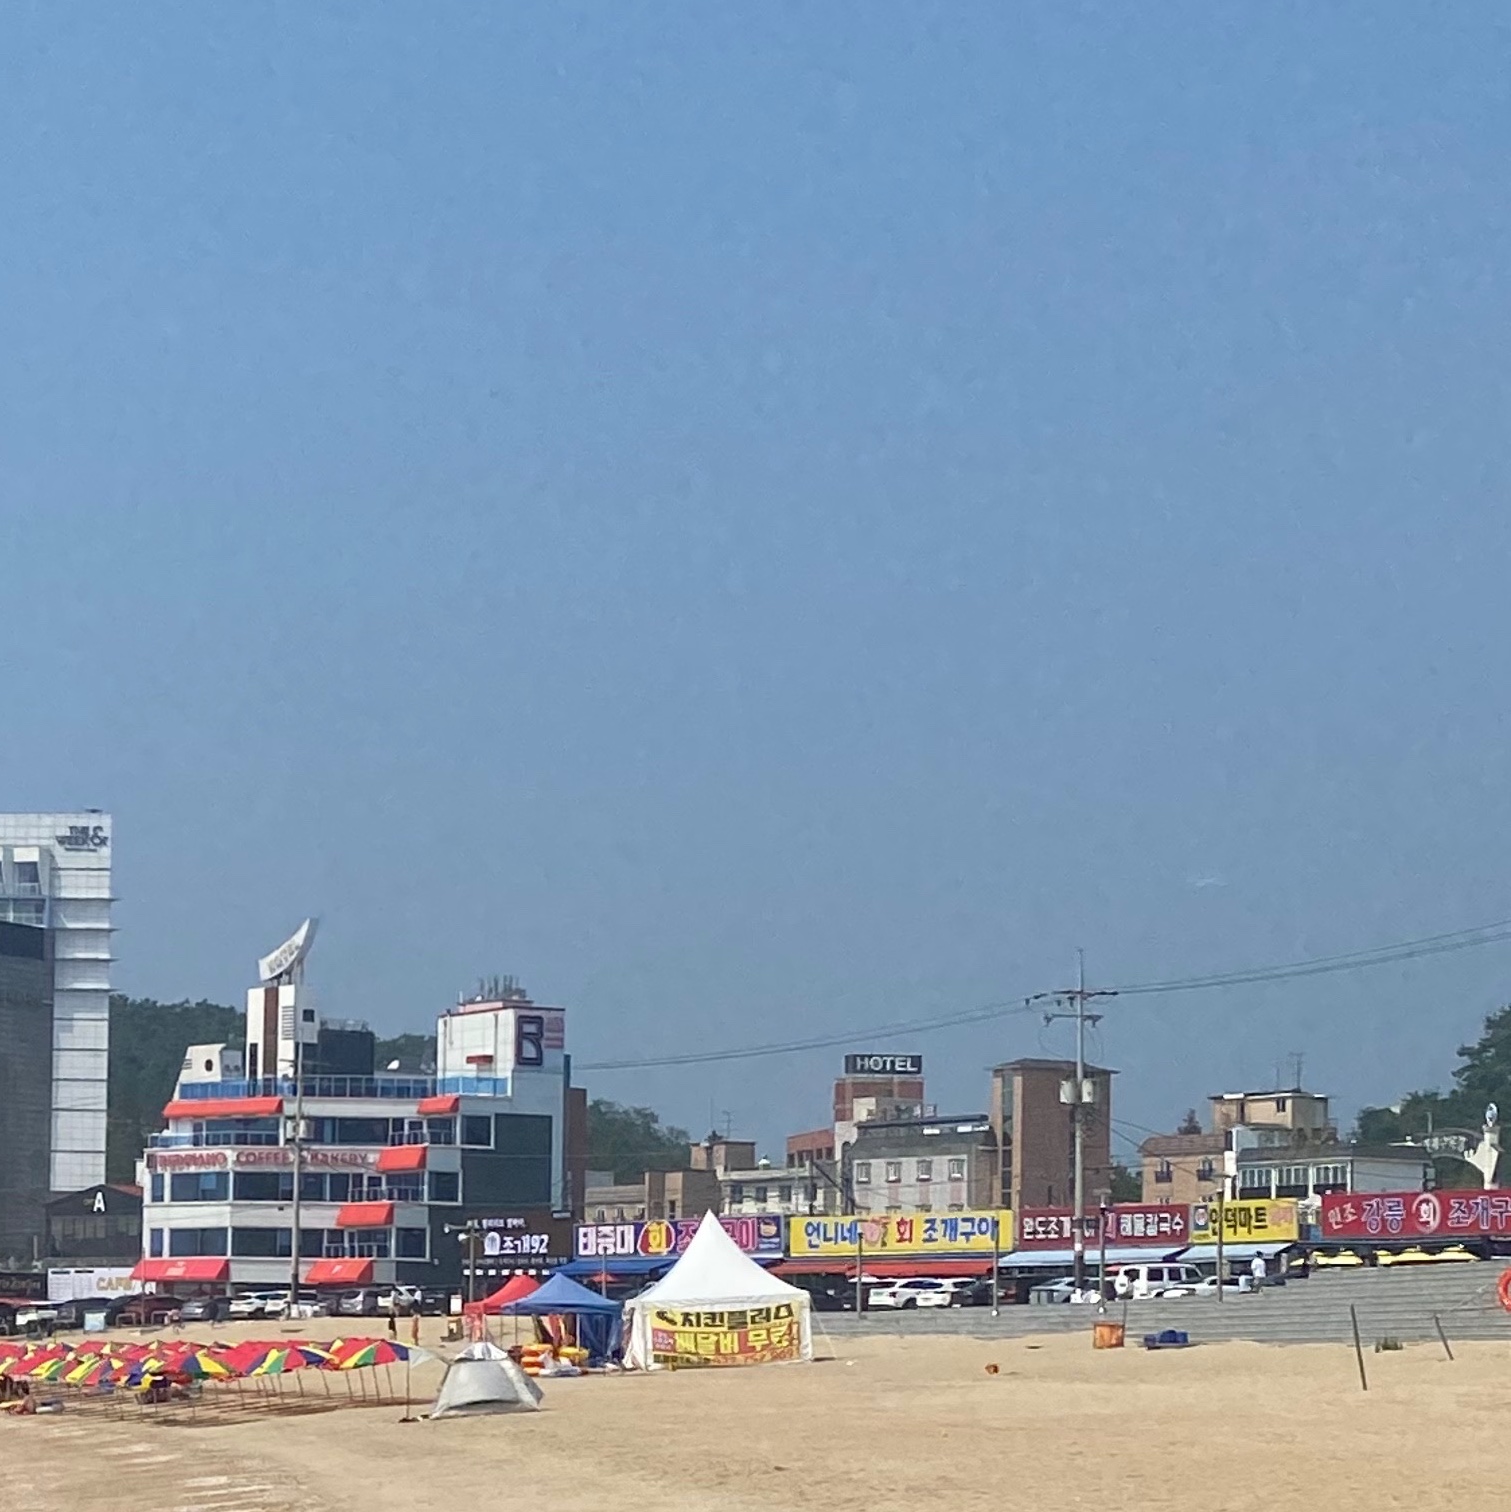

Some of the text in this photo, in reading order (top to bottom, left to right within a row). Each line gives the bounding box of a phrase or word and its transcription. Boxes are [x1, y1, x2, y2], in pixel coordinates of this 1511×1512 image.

[855, 1056, 919, 1072] HOTEL
[236, 1150, 291, 1164] COFFEE
[92, 1191, 106, 1212] A
[1361, 1197, 1407, 1234] 강릉
[1418, 1201, 1435, 1228] 회
[646, 1221, 669, 1254] 회
[804, 1218, 861, 1249] 언니네
[895, 1216, 914, 1244] 회
[922, 1215, 1001, 1244] 조개구이
